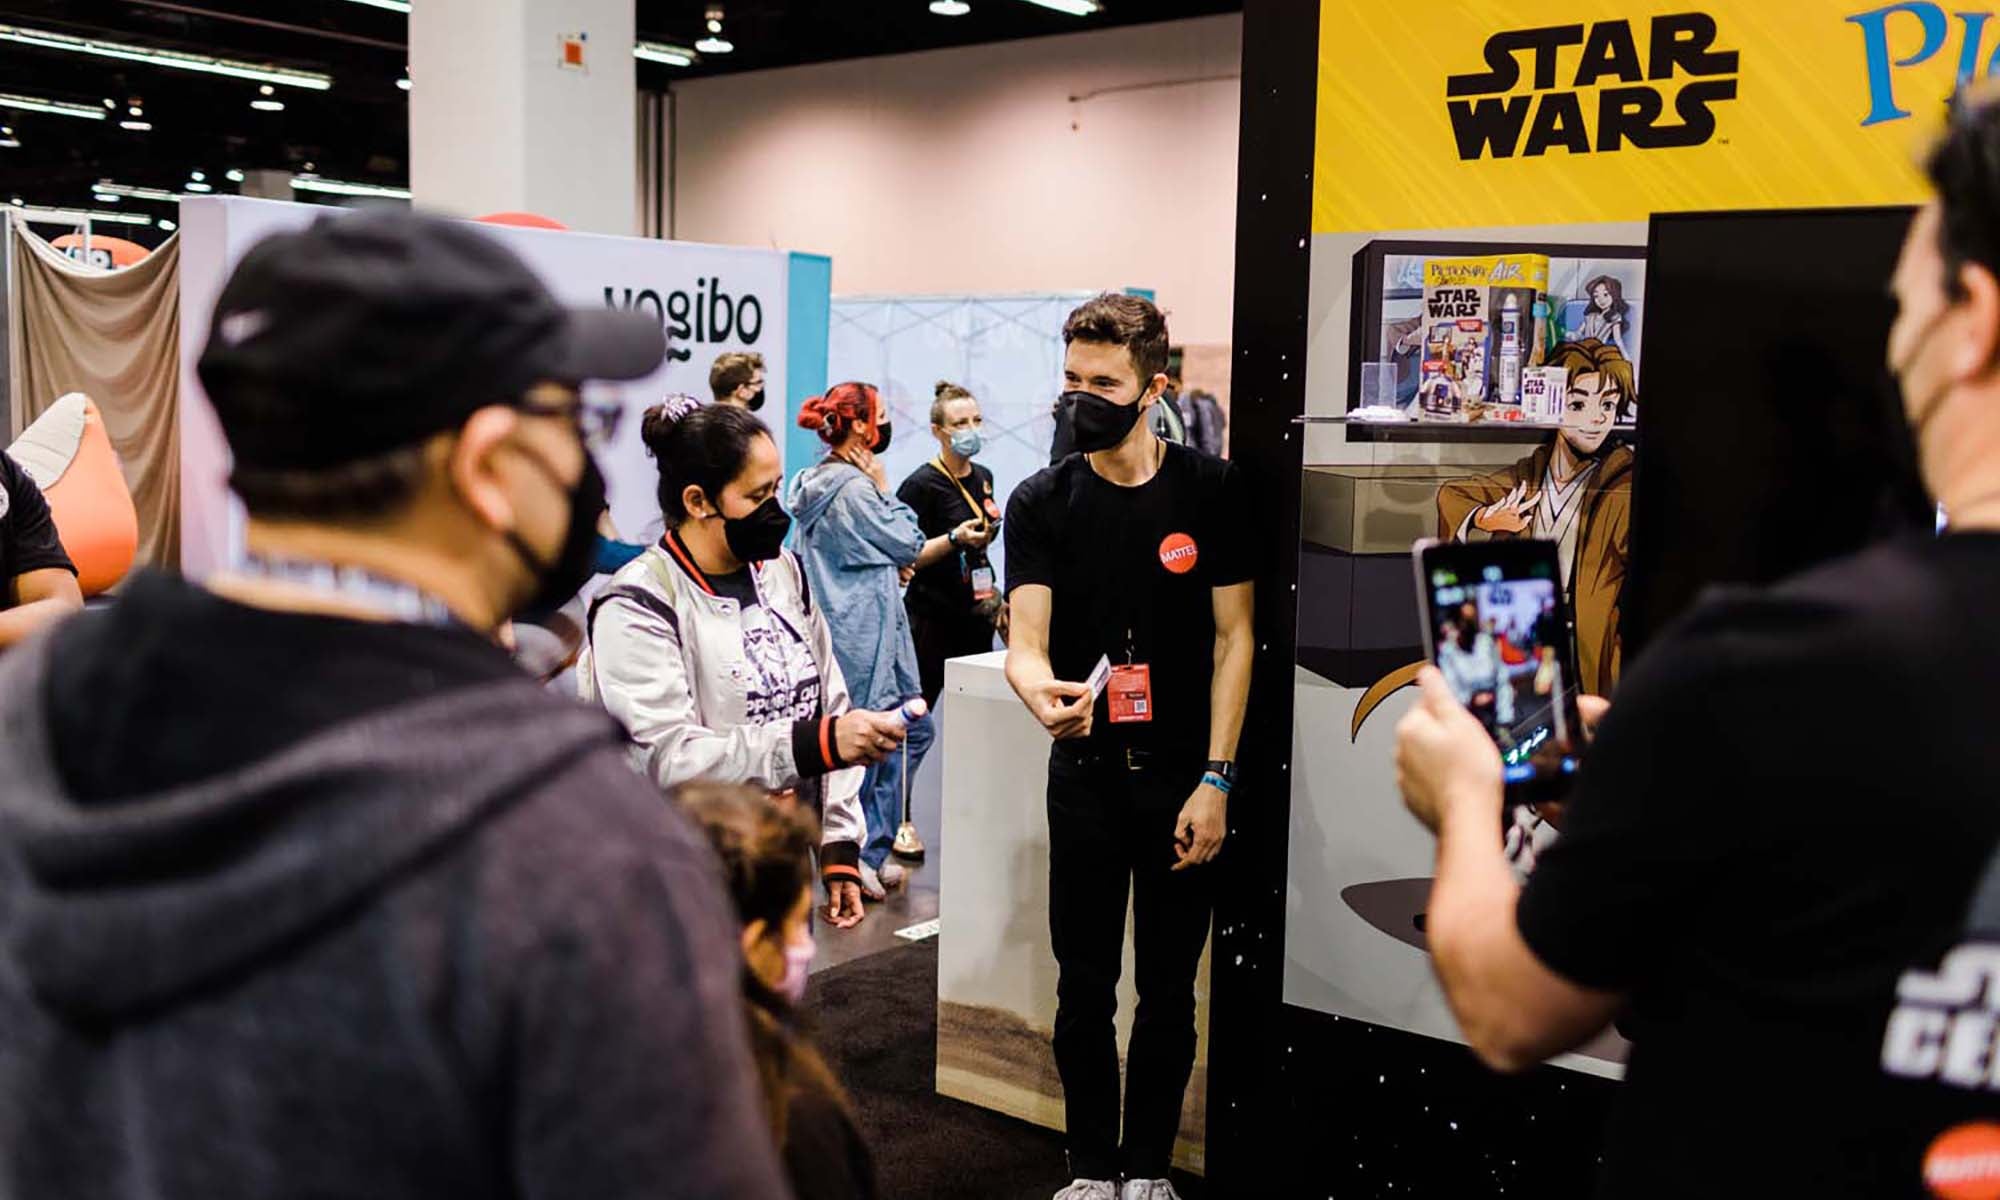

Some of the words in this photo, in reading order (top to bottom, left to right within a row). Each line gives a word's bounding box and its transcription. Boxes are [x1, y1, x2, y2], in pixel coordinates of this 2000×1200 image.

[1447, 12, 1739, 97] STAR
[1845, 1, 2000, 127] PI
[1447, 79, 1738, 160] WARS
[1428, 289, 1480, 303] STAR
[1428, 303, 1480, 318] WARS
[1160, 545, 1198, 564] MATTEL
